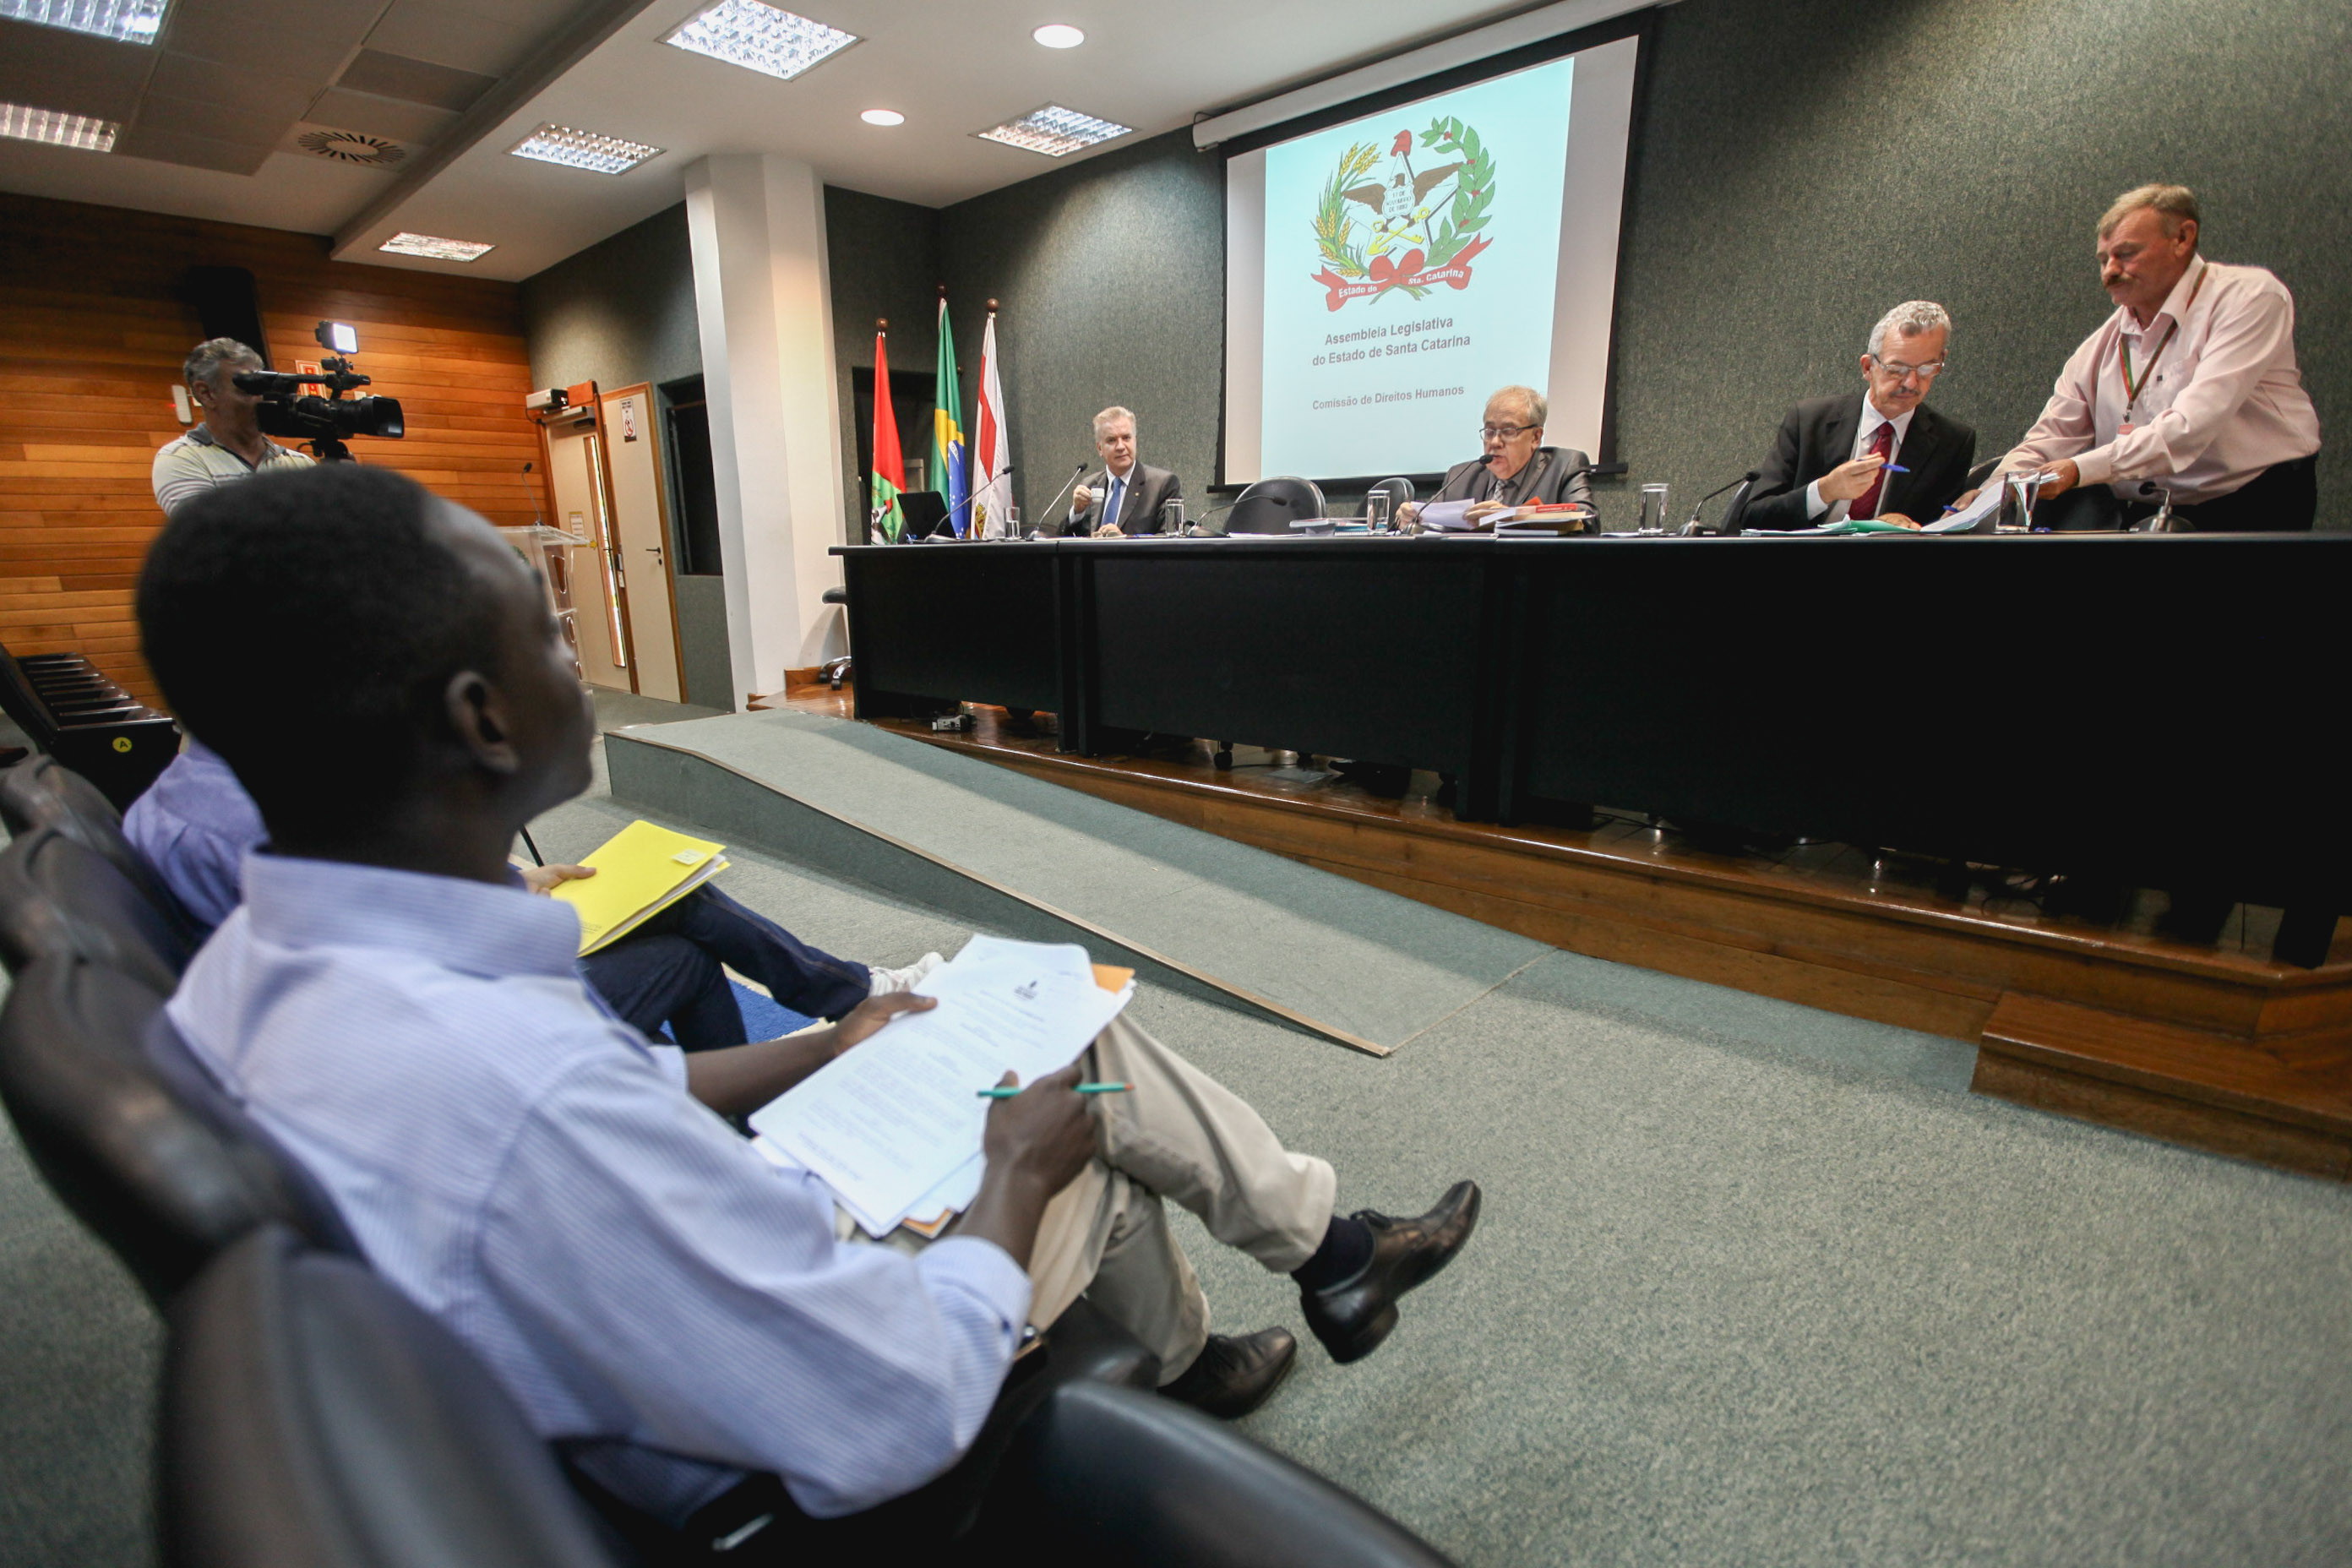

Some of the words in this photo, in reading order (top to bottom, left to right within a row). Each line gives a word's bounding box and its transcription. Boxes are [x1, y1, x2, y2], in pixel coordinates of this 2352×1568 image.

[1338, 286, 1365, 298] Estado
[1426, 268, 1464, 281] Catarina
[1325, 327, 1386, 346] Assembleia
[1391, 317, 1453, 336] Legislativa
[1312, 355, 1326, 366] do
[1328, 349, 1365, 364] Estado
[1369, 346, 1382, 358] de
[1386, 341, 1418, 356] Santa
[1421, 335, 1471, 351] Catarina
[1312, 395, 1358, 410] Comissão
[1360, 395, 1372, 405] de
[1375, 390, 1412, 404] Direitos
[1415, 385, 1464, 400] Humanos
[119, 740, 128, 749] A
